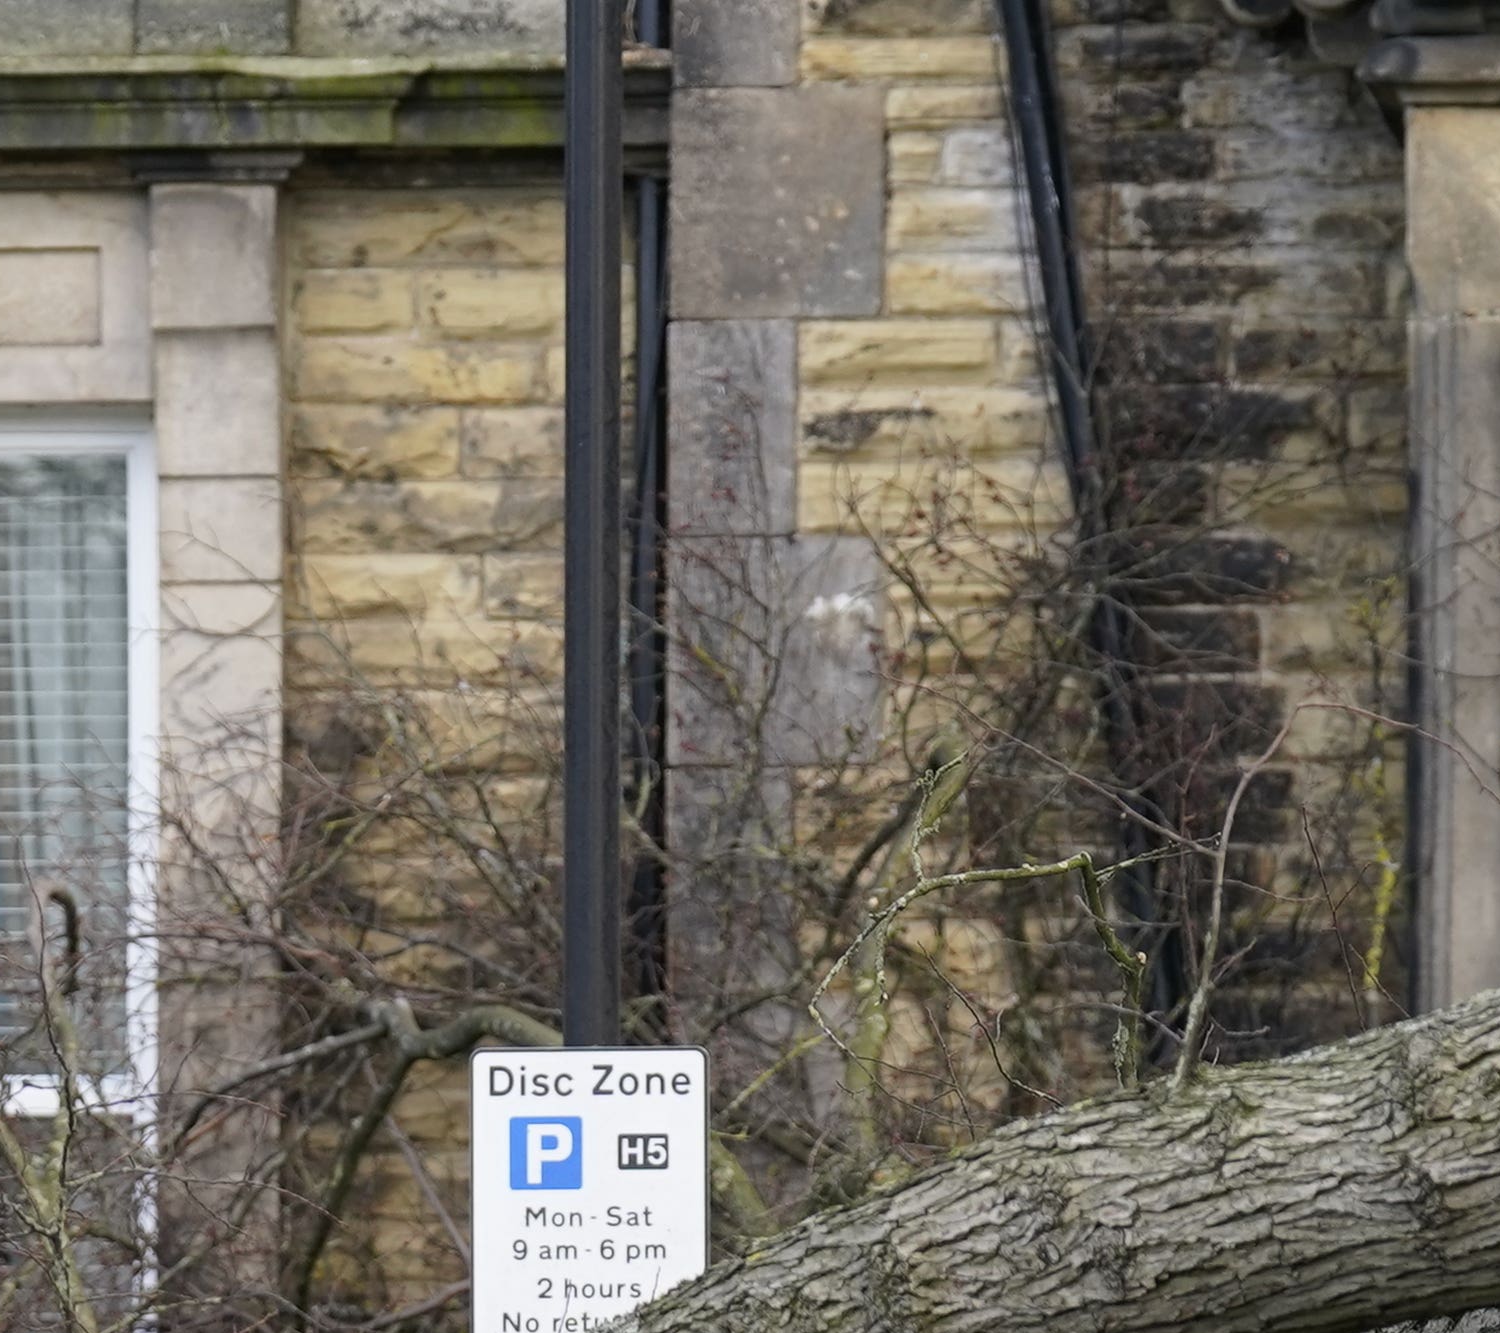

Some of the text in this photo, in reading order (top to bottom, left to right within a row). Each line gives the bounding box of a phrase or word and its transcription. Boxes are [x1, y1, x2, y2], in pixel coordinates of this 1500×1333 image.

[489, 1064, 691, 1097] Disc Zone
[526, 1123, 574, 1185] P
[621, 1137, 668, 1166] H5
[525, 1206, 583, 1228] Mon
[606, 1205, 653, 1227] Sat
[512, 1239, 528, 1261] 9
[600, 1238, 616, 1260] 6
[626, 1243, 667, 1264] pm
[537, 1277, 642, 1299] 2 hours
[503, 1311, 540, 1333] No
